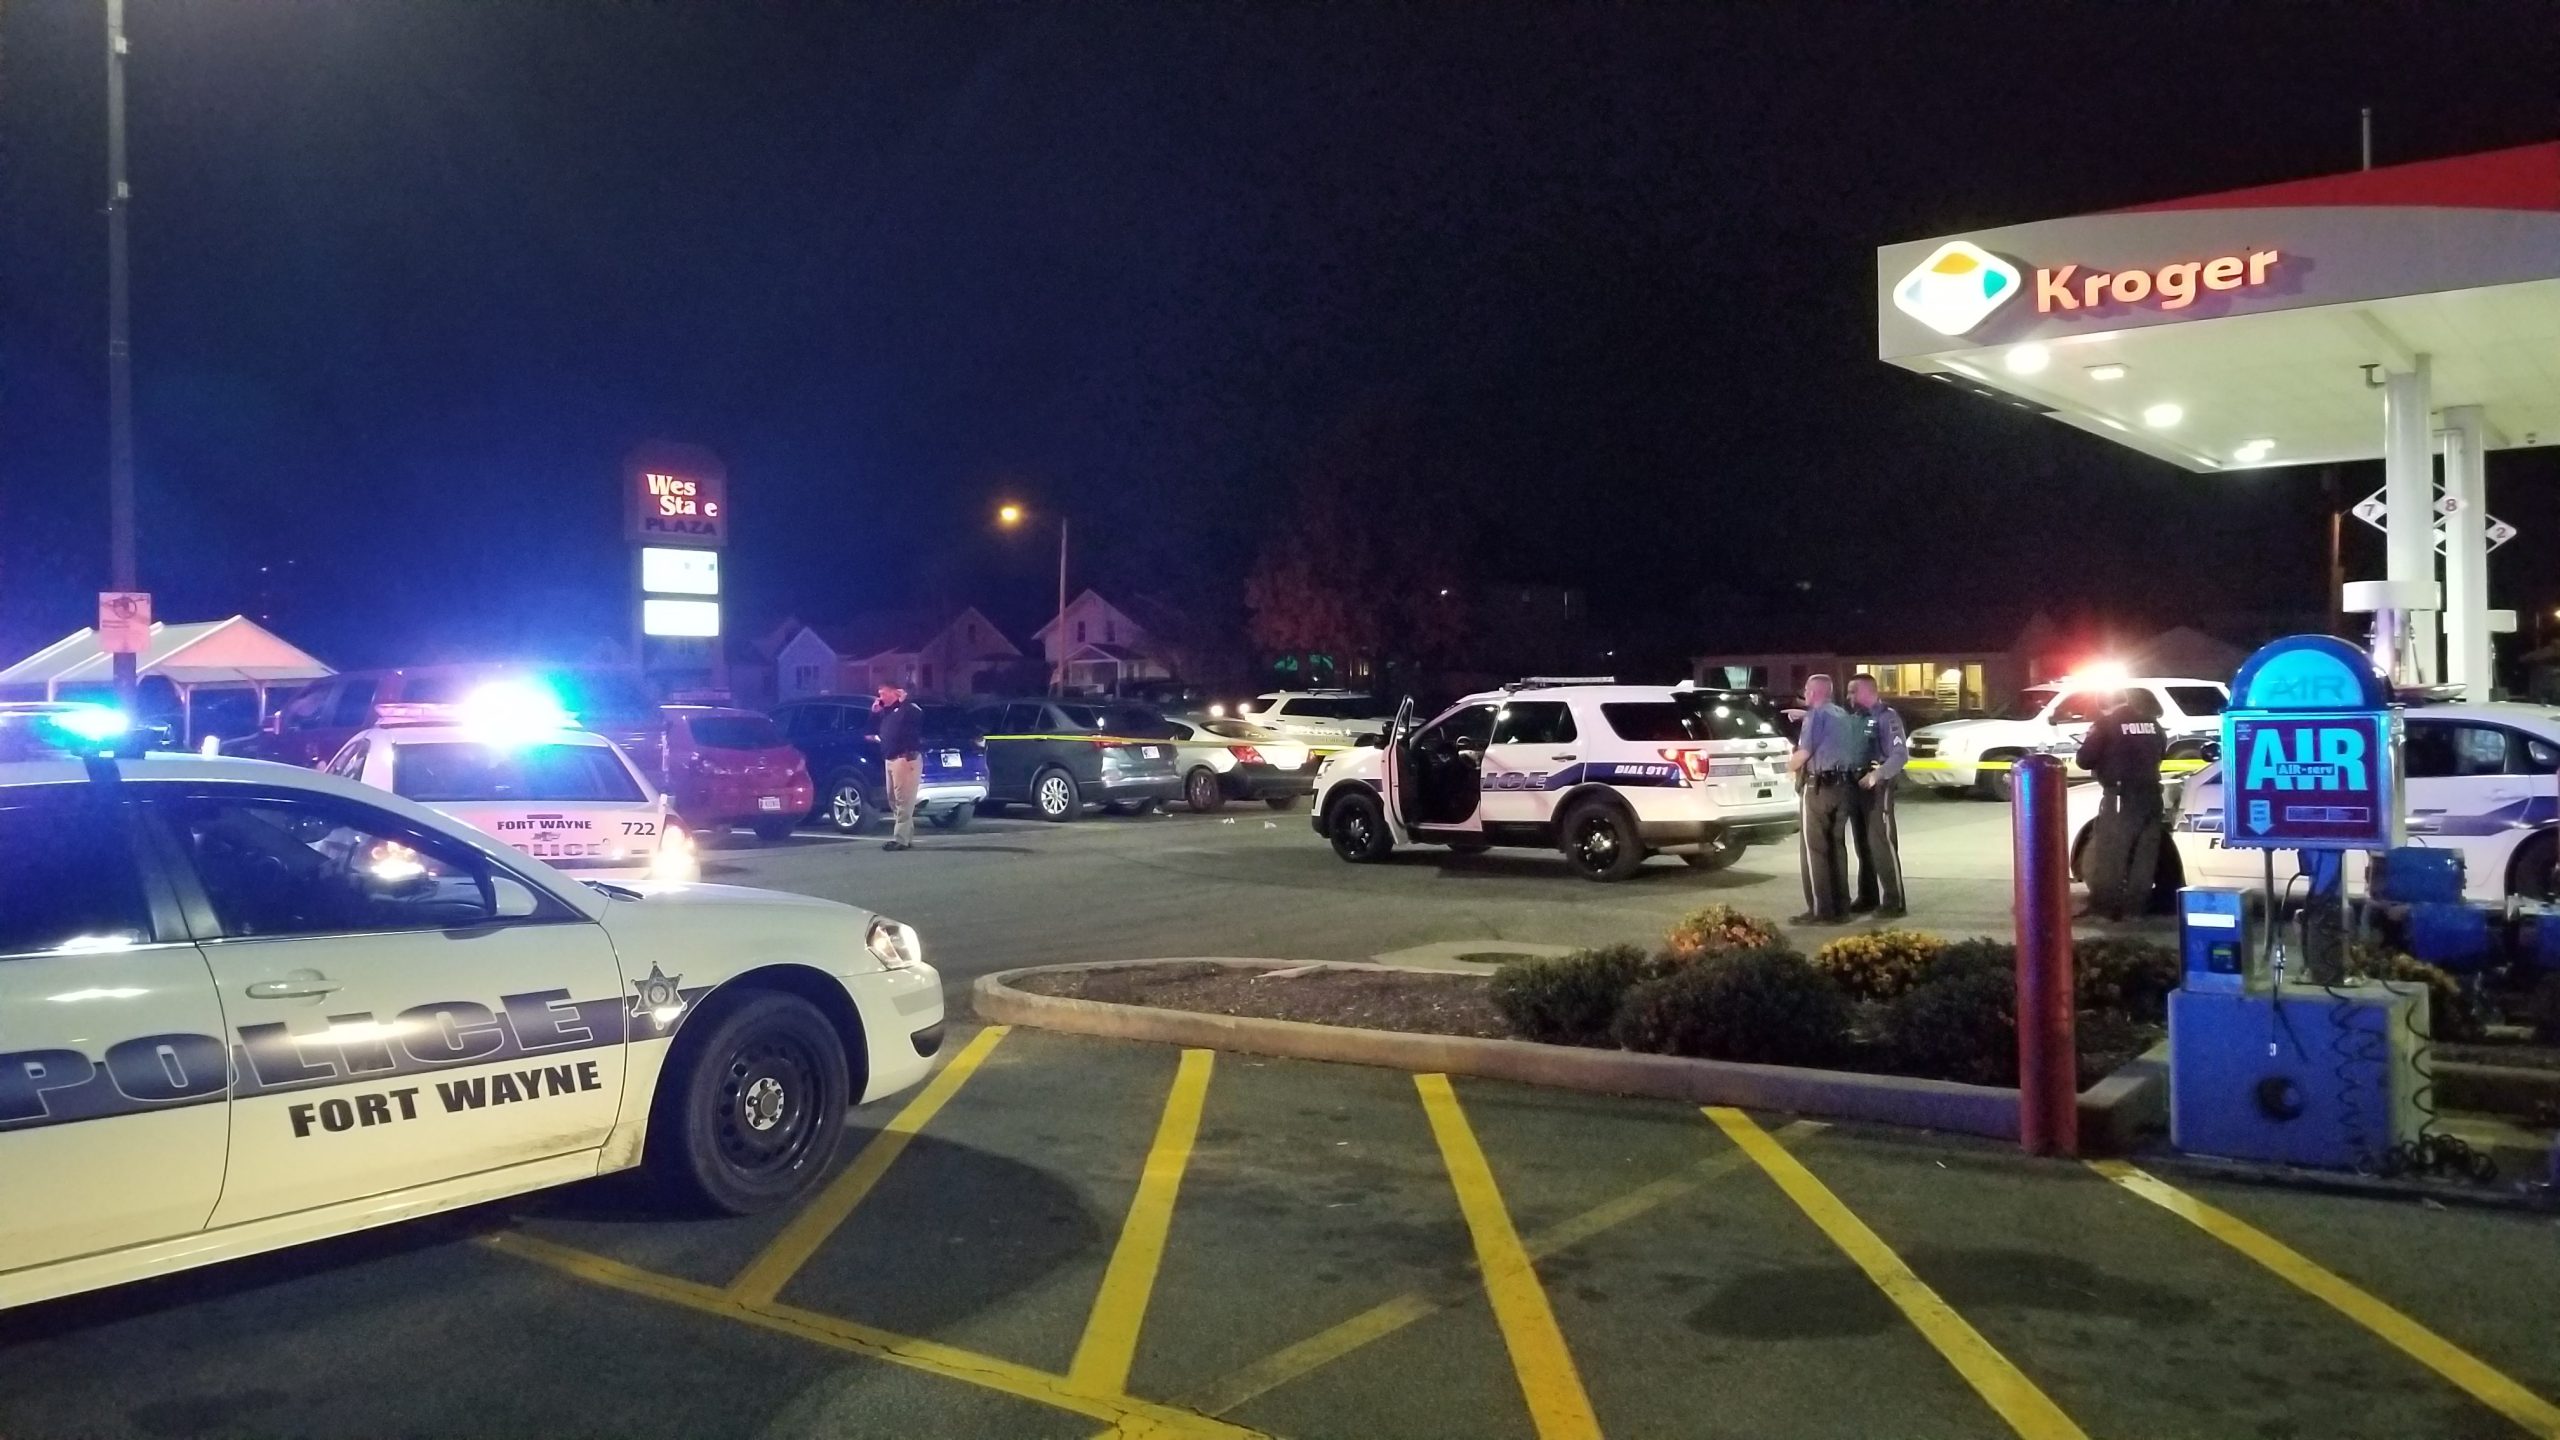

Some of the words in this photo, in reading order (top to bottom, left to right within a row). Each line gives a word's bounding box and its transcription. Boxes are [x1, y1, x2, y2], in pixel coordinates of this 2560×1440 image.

[2036, 250, 2278, 313] Kroger
[2363, 503, 2376, 517] 7
[2445, 498, 2458, 512] 8
[645, 517, 718, 536] PLAZA
[2495, 526, 2507, 539] 2
[2267, 674, 2346, 701] AIR
[2120, 722, 2157, 736] POLICE
[2245, 727, 2369, 791] AIR
[1614, 764, 1644, 775] DIAL
[1645, 765, 1669, 776] 911
[497, 820, 535, 831] FORT
[539, 819, 593, 830] WAYNE
[621, 822, 656, 836] 722
[0, 987, 594, 1122] POLICE
[289, 1086, 419, 1138] FORT
[435, 1060, 602, 1113] WAYNE
